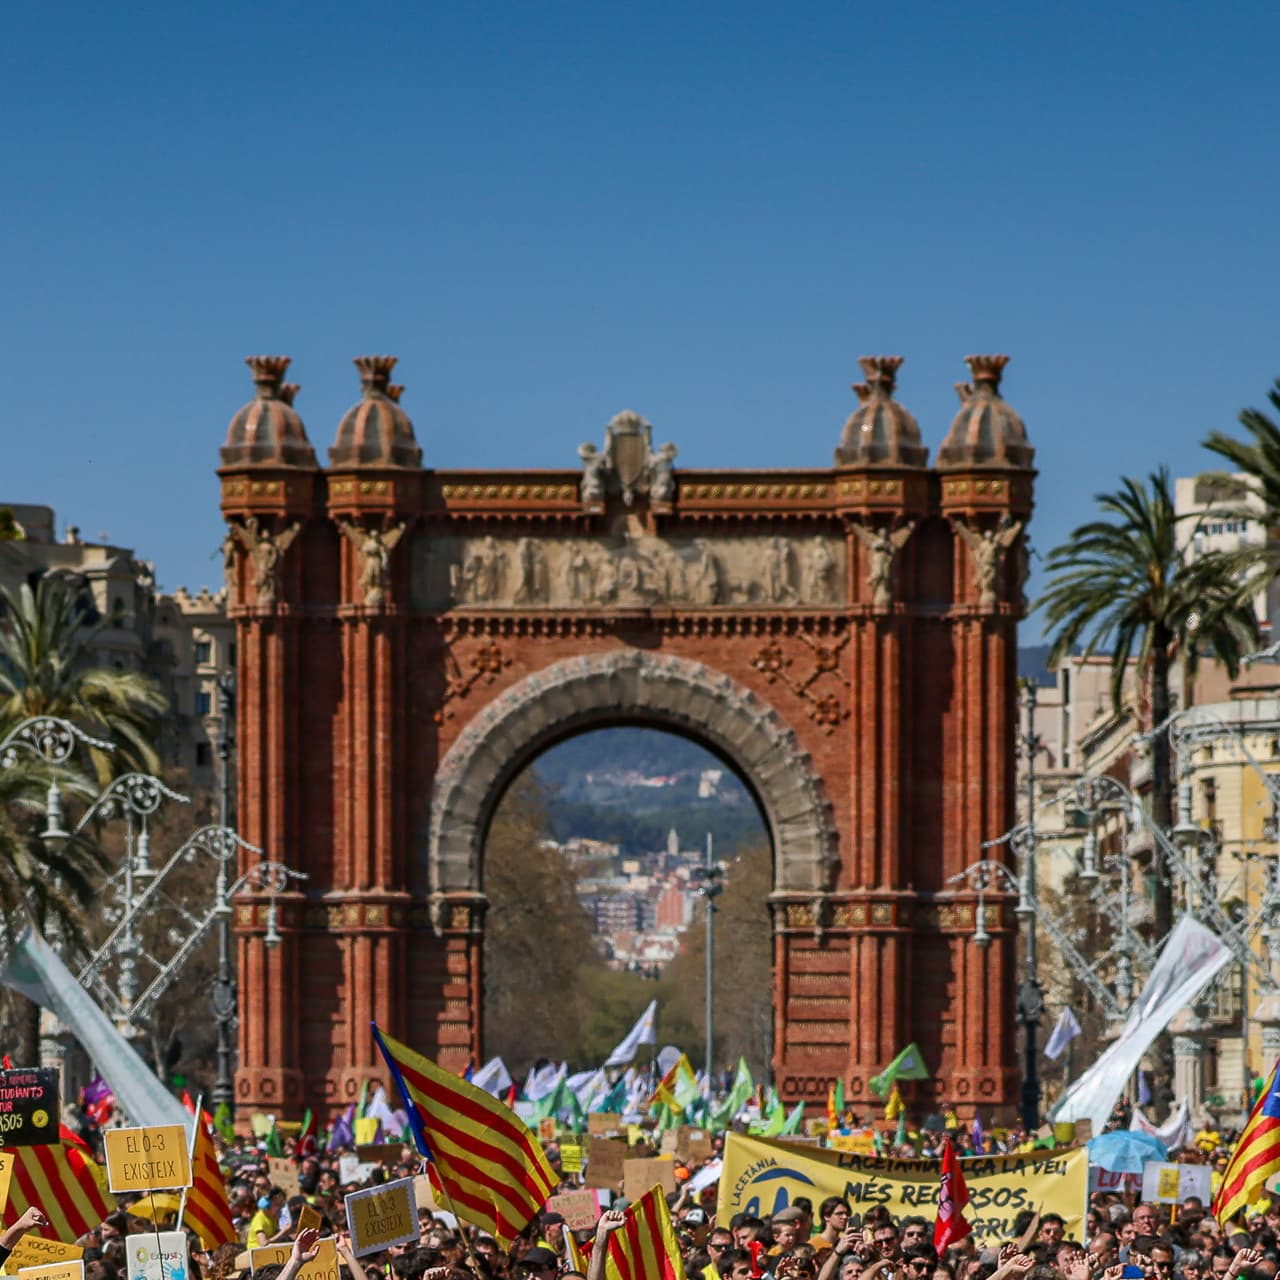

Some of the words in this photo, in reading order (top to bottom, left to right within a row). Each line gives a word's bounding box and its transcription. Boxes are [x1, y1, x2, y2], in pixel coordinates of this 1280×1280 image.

[127, 1136, 140, 1153] EL
[143, 1134, 165, 1152] 0-3
[124, 1161, 176, 1181] EXISTEIX
[961, 1158, 996, 1177] LÇA
[844, 1176, 891, 1205] MÉS
[902, 1185, 1035, 1210] RECRSOS,
